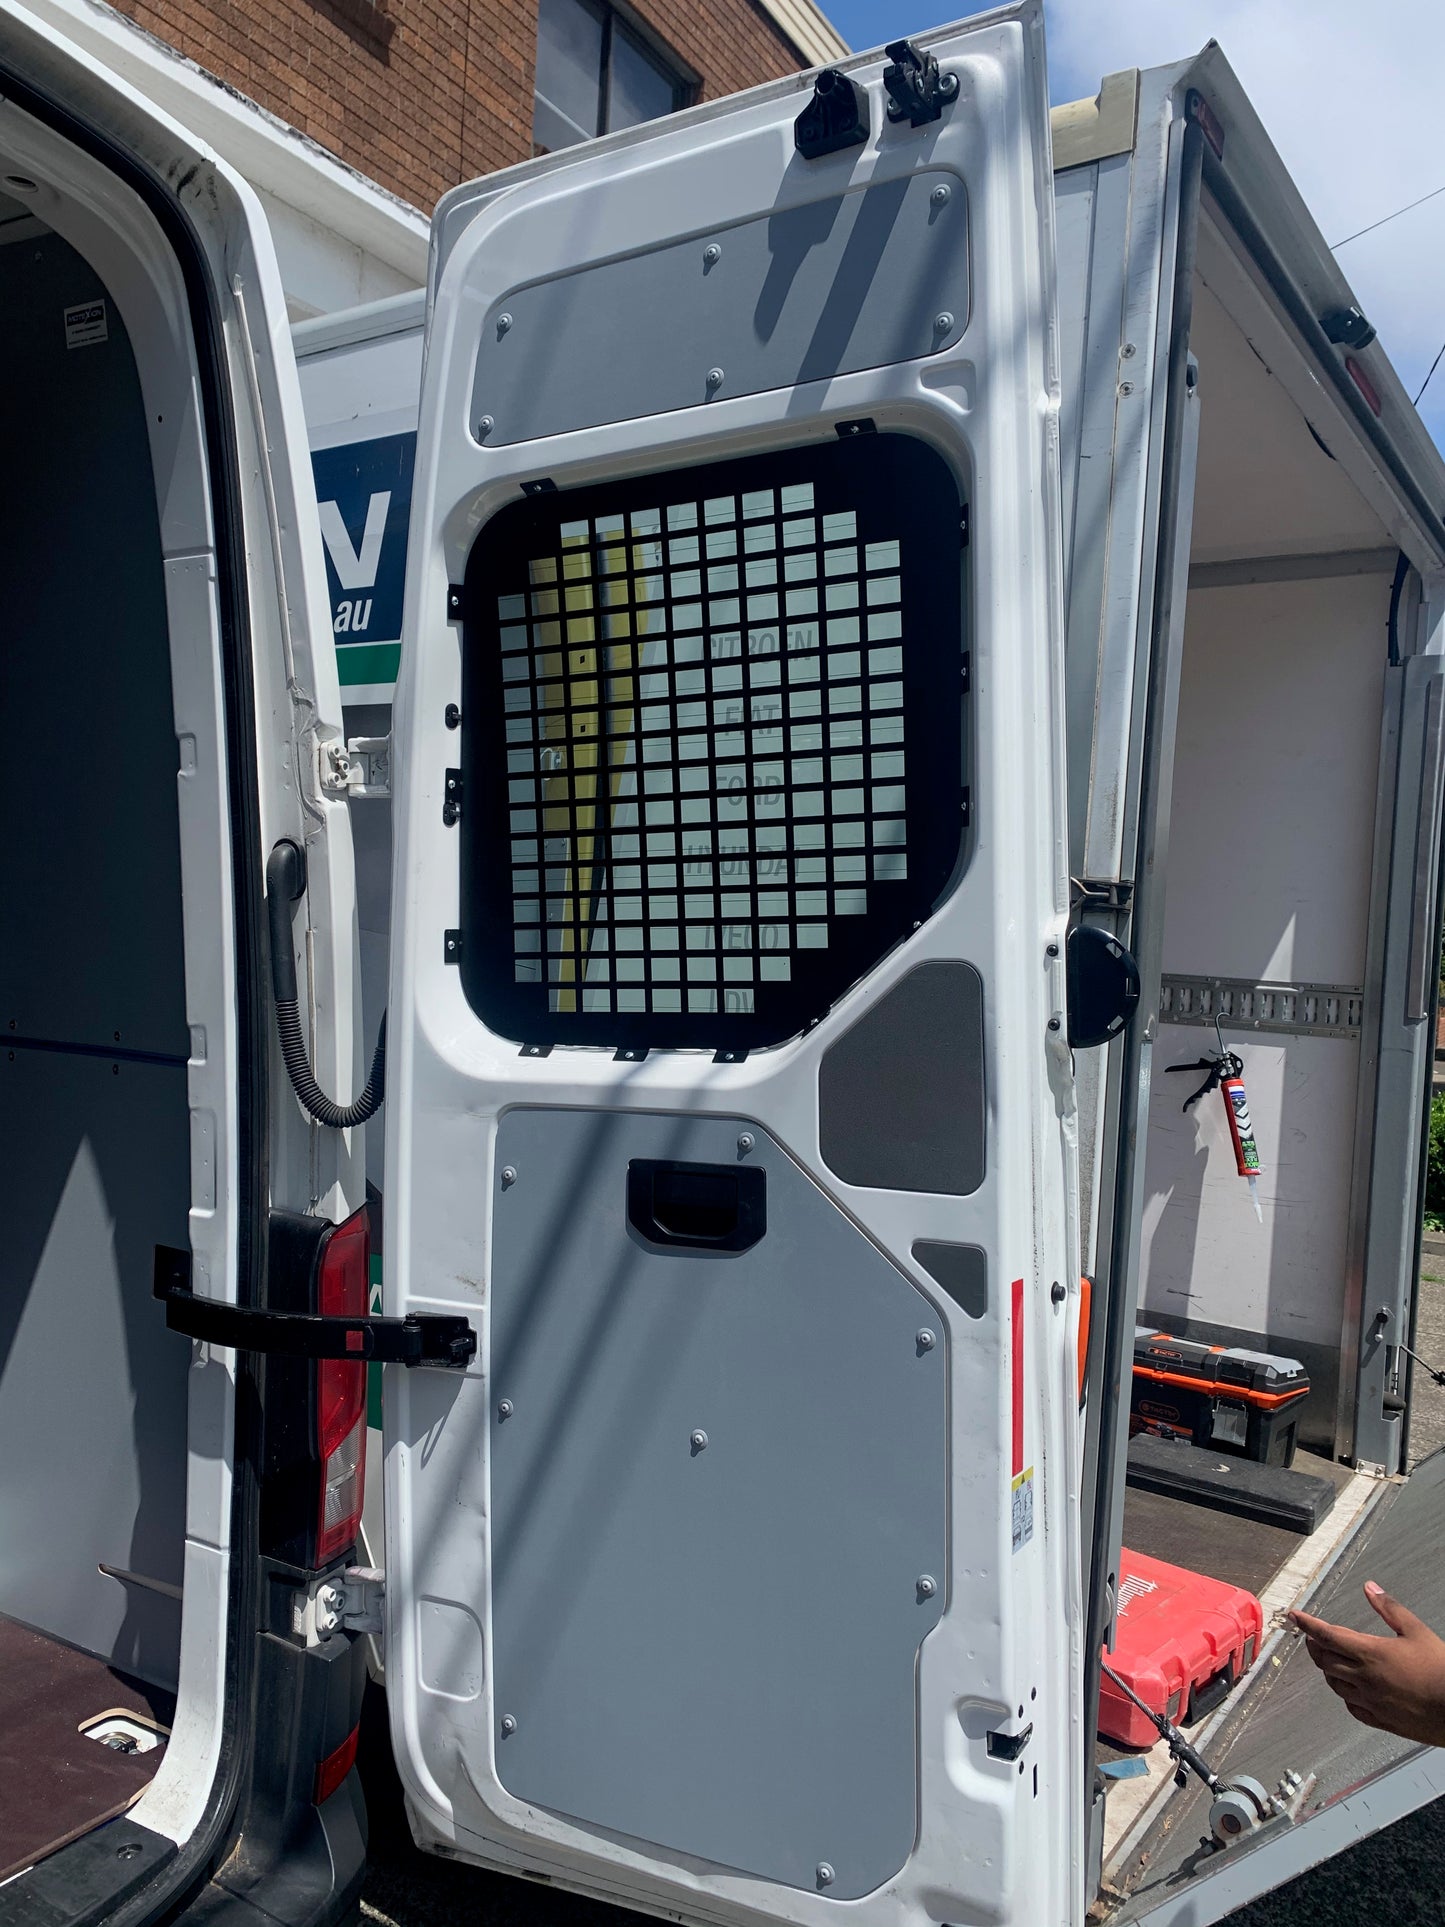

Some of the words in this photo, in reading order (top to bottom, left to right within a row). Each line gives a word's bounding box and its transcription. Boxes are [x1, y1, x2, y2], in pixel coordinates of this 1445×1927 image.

[334, 599, 373, 633] au
[701, 629, 812, 664] ITON
[705, 925, 779, 949] IECO
